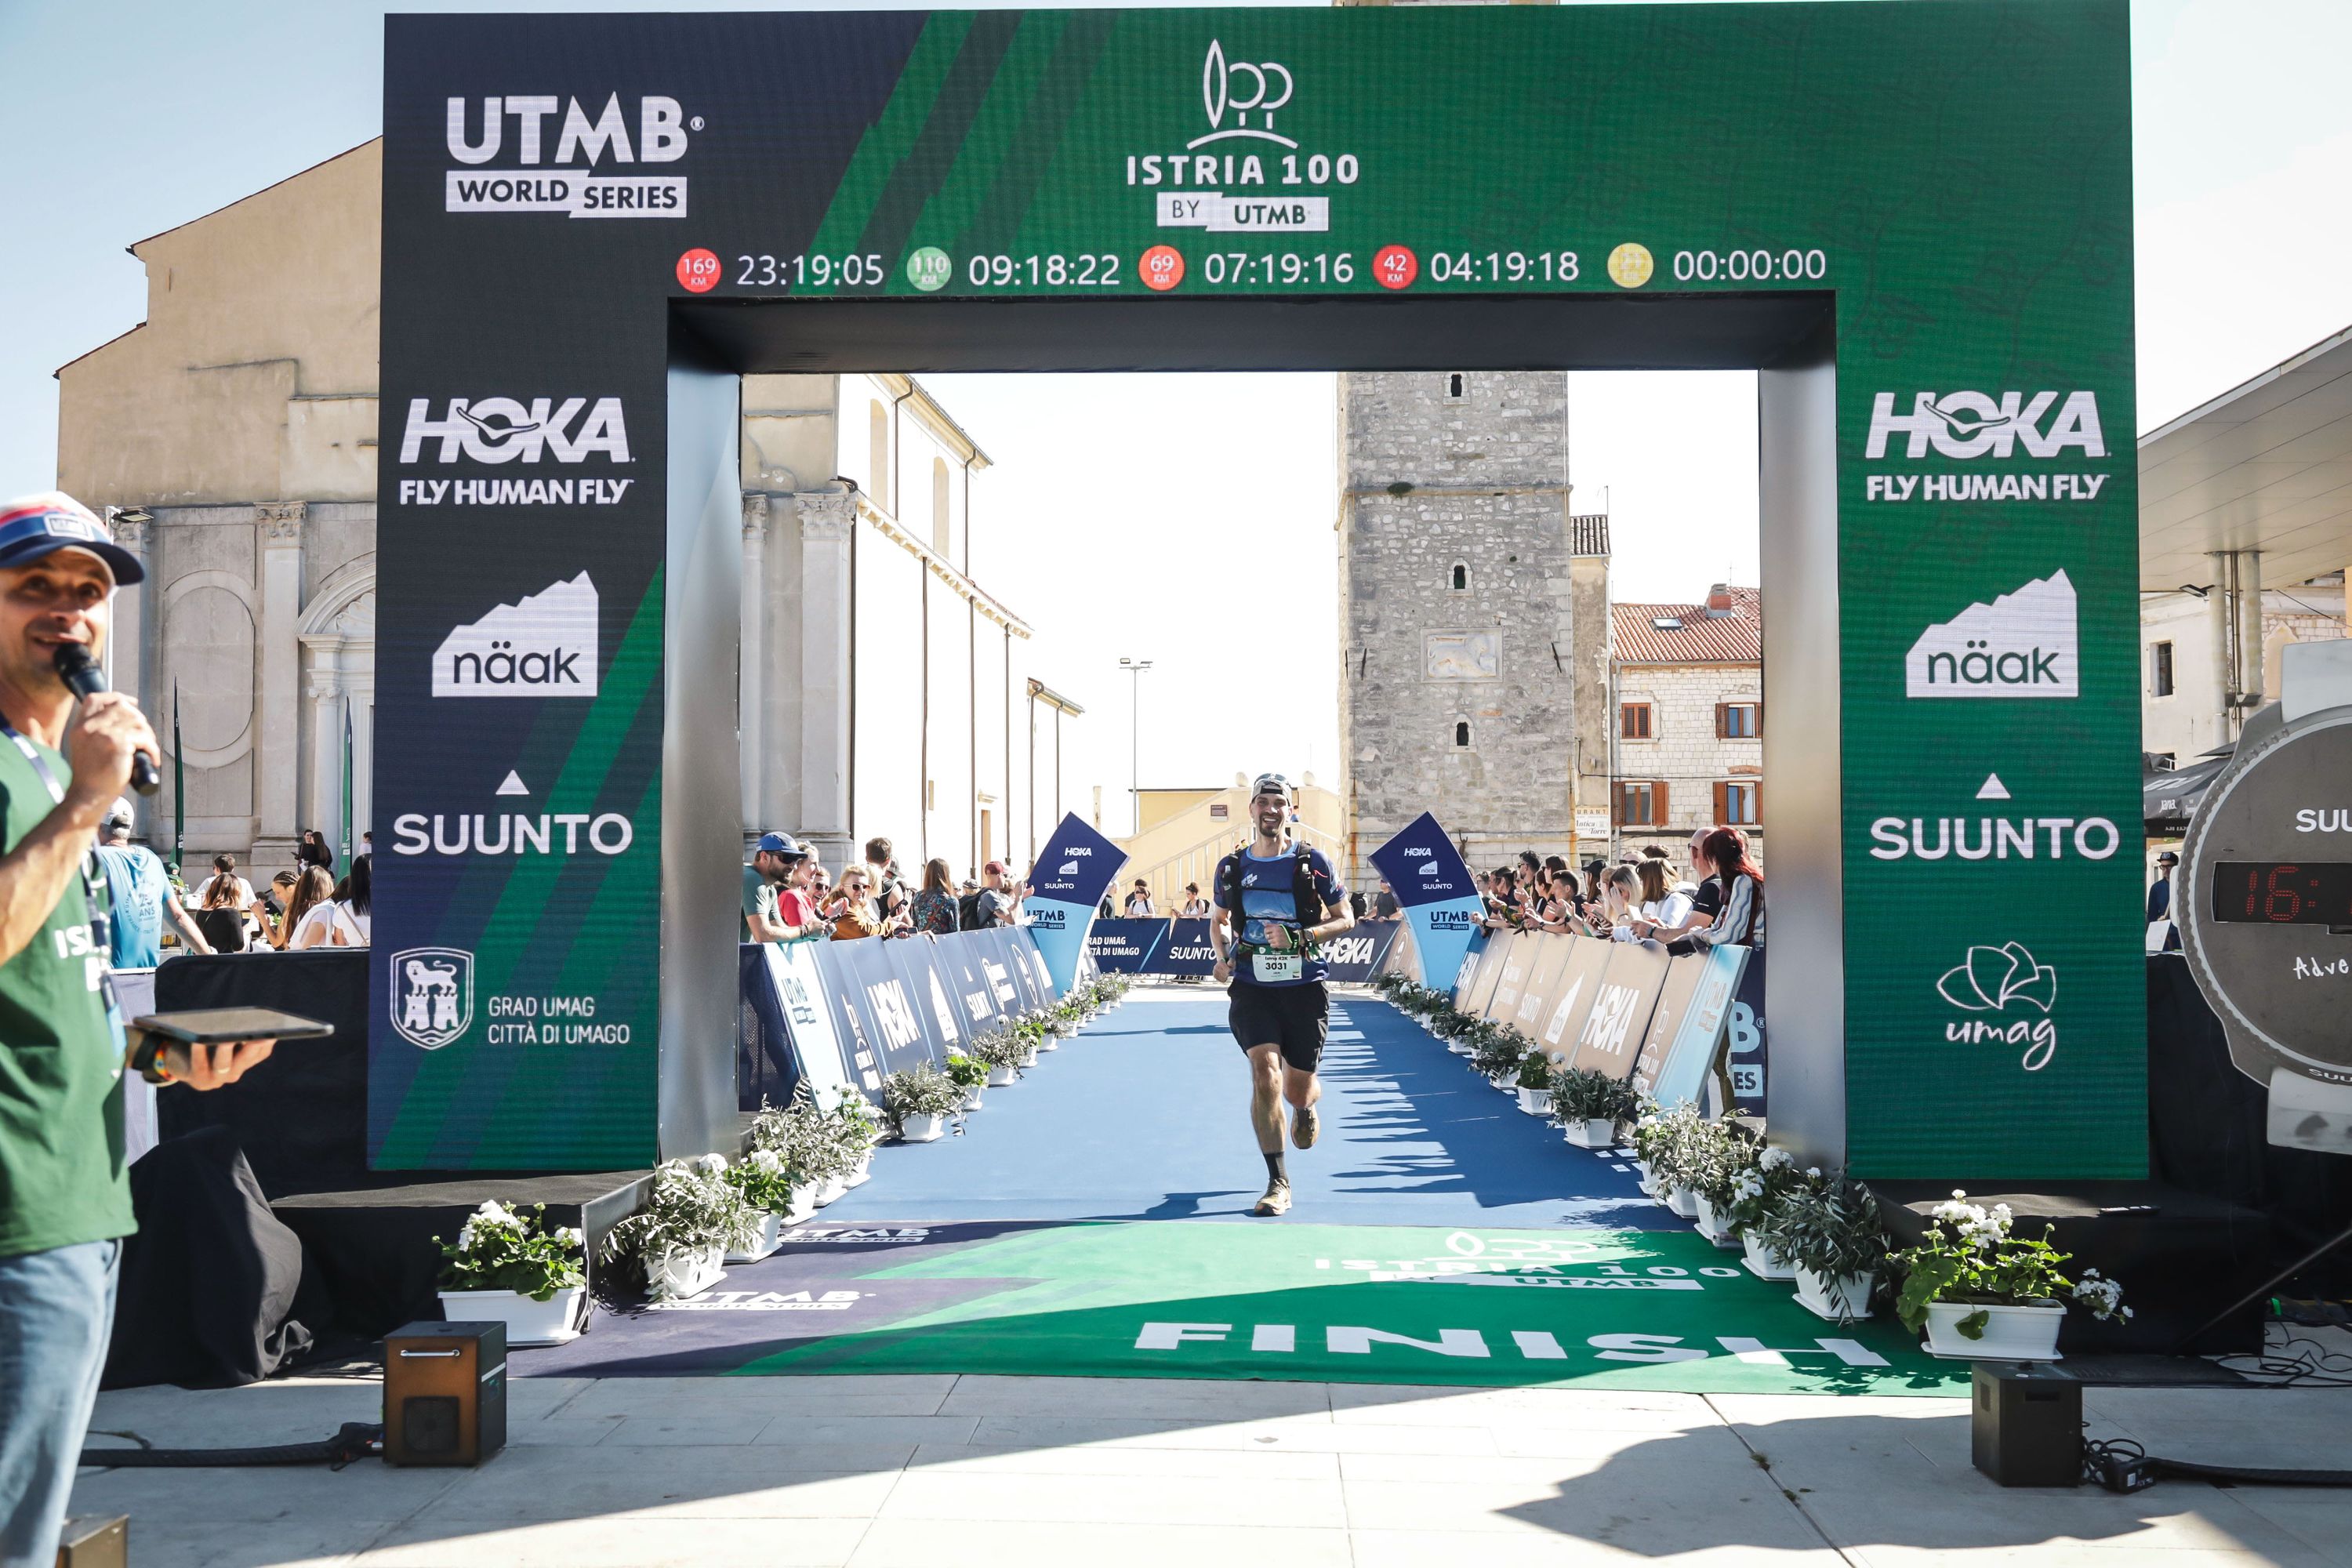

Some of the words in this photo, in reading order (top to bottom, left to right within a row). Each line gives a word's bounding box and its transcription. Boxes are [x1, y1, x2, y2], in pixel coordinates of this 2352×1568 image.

[1128, 155, 1264, 185] ISTRIA
[1282, 154, 1358, 184] 100
[458, 180, 568, 202] WORLD
[584, 187, 677, 209] SERIES
[1173, 200, 1199, 219] BY
[1235, 205, 1305, 225] UTMB
[684, 257, 716, 274] 169
[737, 255, 883, 285] 23:19:05
[914, 256, 947, 274] 110
[969, 255, 1120, 285] 09:18:22
[1150, 255, 1174, 272] 69
[1205, 253, 1353, 283] 07:19:16
[1384, 255, 1406, 270] 42
[1432, 252, 1579, 281] 04:19:18
[1674, 250, 1825, 280] 00:00:00
[1154, 274, 1169, 284] KM
[1388, 273, 1403, 282] KM
[400, 397, 630, 463] HOKA
[1866, 391, 2106, 459] HOKA
[401, 481, 450, 504] FLY
[455, 480, 573, 504] HUMAN
[579, 479, 627, 504] FLY
[1867, 476, 1918, 500] FLY
[1924, 475, 2046, 500] HUMAN
[2053, 474, 2101, 499] FLY
[453, 641, 581, 684] näak
[1928, 640, 2060, 684] näak
[393, 813, 633, 855] SUUNTO
[1870, 817, 2119, 860] SUUNTO
[1065, 848, 1092, 856] HOKA
[1404, 848, 1432, 856] HOKA
[1431, 911, 1469, 922] UTMB
[1112, 947, 1139, 956] UMAGO
[1169, 946, 1217, 960] SUUNTO
[1323, 937, 1374, 964] HOKA
[488, 996, 538, 1017] GRAD
[543, 996, 595, 1017] UMAG
[1581, 983, 1639, 1054] HOKA
[488, 1020, 538, 1044] CITTÀ
[543, 1024, 560, 1044] DI
[565, 1024, 630, 1044] UMAGO
[1946, 1019, 2056, 1070] umag
[1315, 1258, 1560, 1276] ISTRIA
[1597, 1265, 1740, 1278] 100
[1515, 1276, 1658, 1288] UTMB
[1134, 1322, 1892, 1367] FINISH
